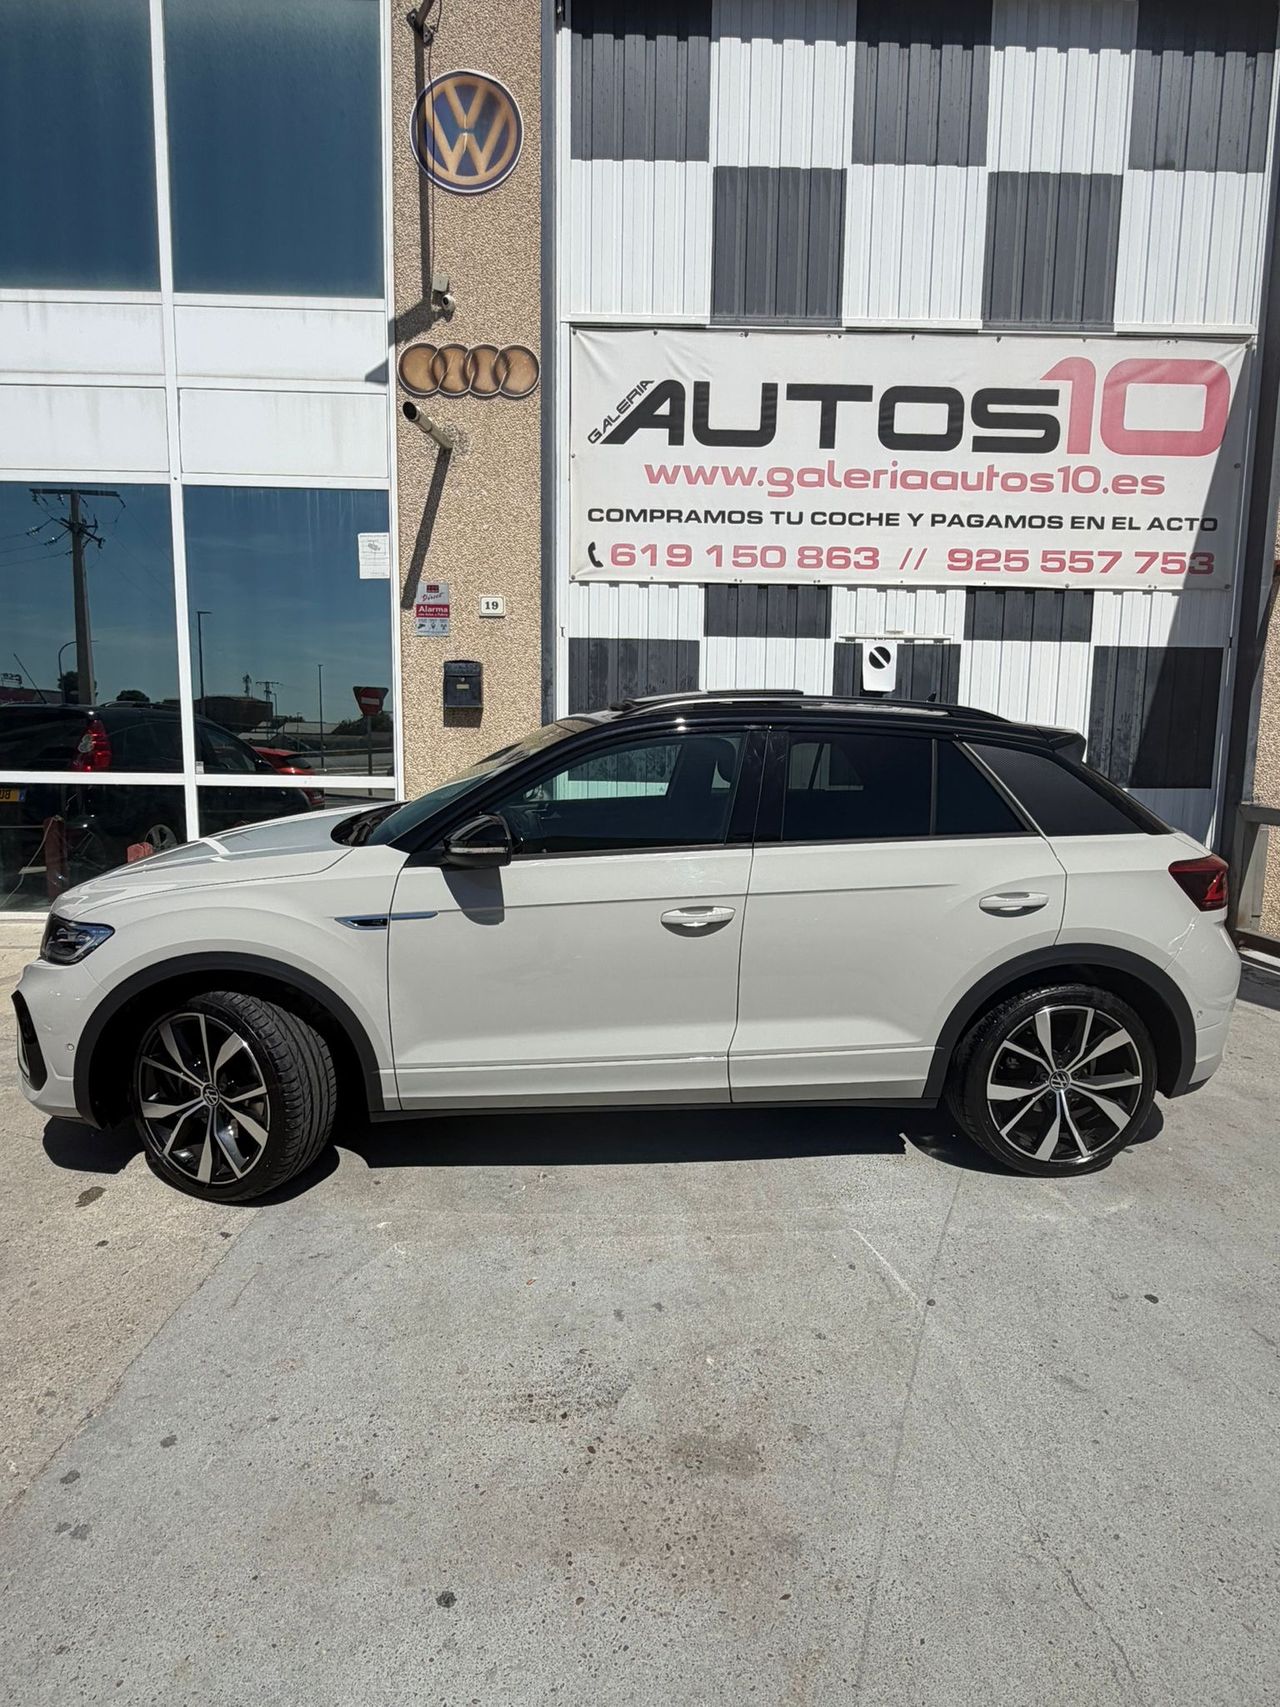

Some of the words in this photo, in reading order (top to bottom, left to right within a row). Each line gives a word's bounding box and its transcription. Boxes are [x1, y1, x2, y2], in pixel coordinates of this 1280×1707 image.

[587, 379, 655, 444] GALERIA
[644, 459, 1166, 498] www.galeriaautos10.es
[587, 508, 763, 525] COMPRAMOS
[770, 510, 804, 526] TU
[810, 511, 901, 527] COCHE
[907, 512, 925, 528] Y
[930, 513, 1063, 530] PAGAMOS
[1070, 515, 1106, 531] EN
[1111, 516, 1142, 531] EL
[1146, 516, 1219, 532] ACTO
[610, 543, 693, 568] 619
[705, 543, 787, 569] 150
[797, 545, 880, 570] 863
[946, 548, 1030, 573] 925
[1040, 549, 1123, 574] 557
[1134, 551, 1215, 576] 753
[418, 605, 448, 613] Alarma
[485, 600, 499, 610] 19
